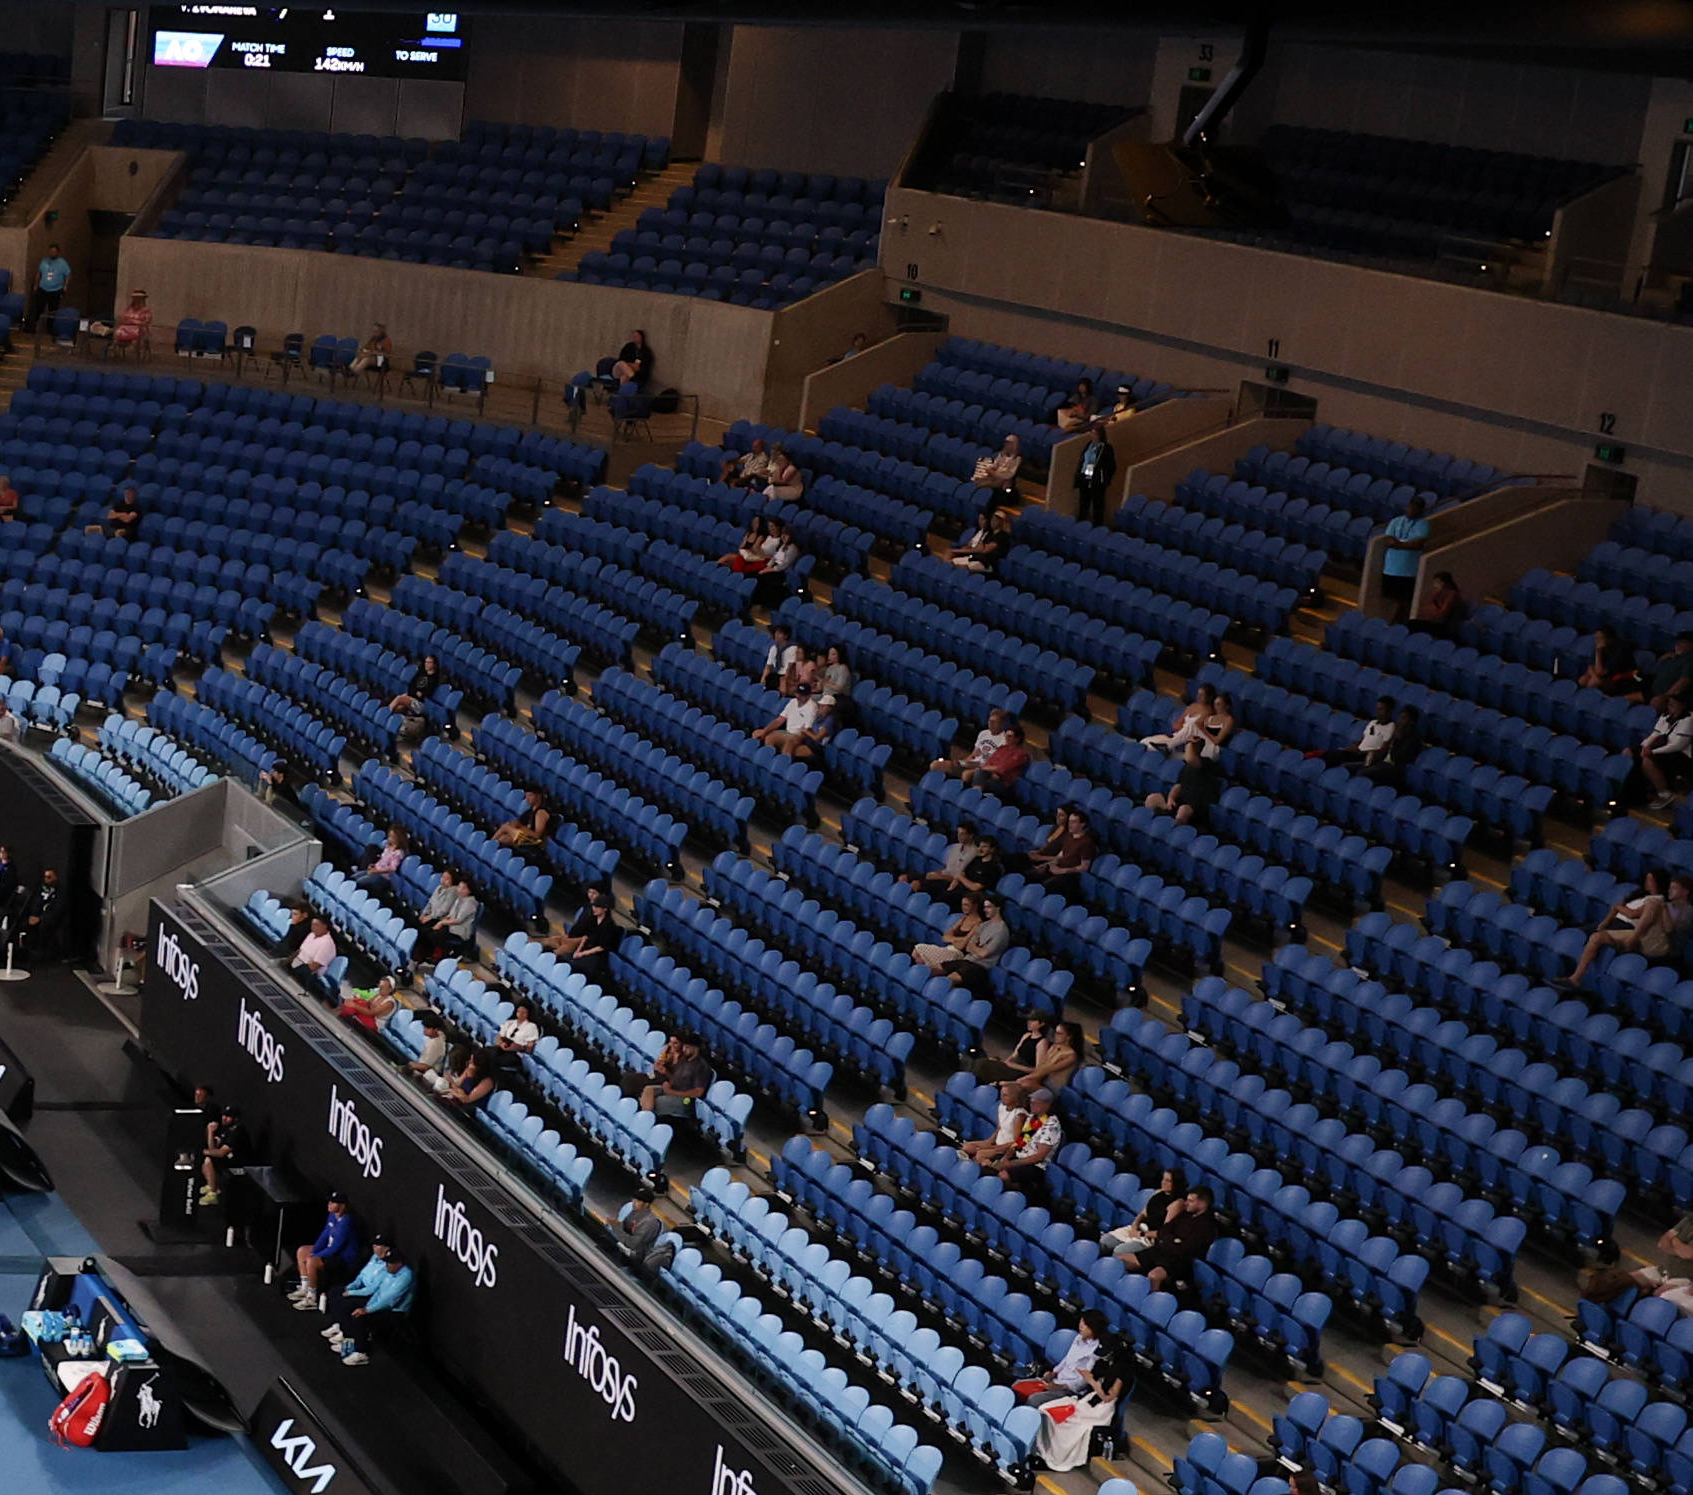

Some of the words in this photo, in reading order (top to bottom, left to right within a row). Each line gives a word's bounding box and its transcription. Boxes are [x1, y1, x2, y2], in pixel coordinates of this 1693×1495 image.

[232, 42, 263, 54] MATCH
[265, 43, 286, 55] TIME
[326, 46, 355, 58] SPEED
[395, 50, 409, 61] TO
[410, 51, 438, 62] SERVE
[907, 263, 918, 280] 10
[1267, 339, 1279, 358] 11
[1598, 412, 1614, 434] 12
[157, 922, 200, 1000] Infosys
[238, 997, 285, 1083] Infosys
[328, 1084, 383, 1178] Infosys
[434, 1183, 499, 1288] Infosys
[564, 1304, 638, 1422] Infosys
[83, 1402, 106, 1437] Wilson
